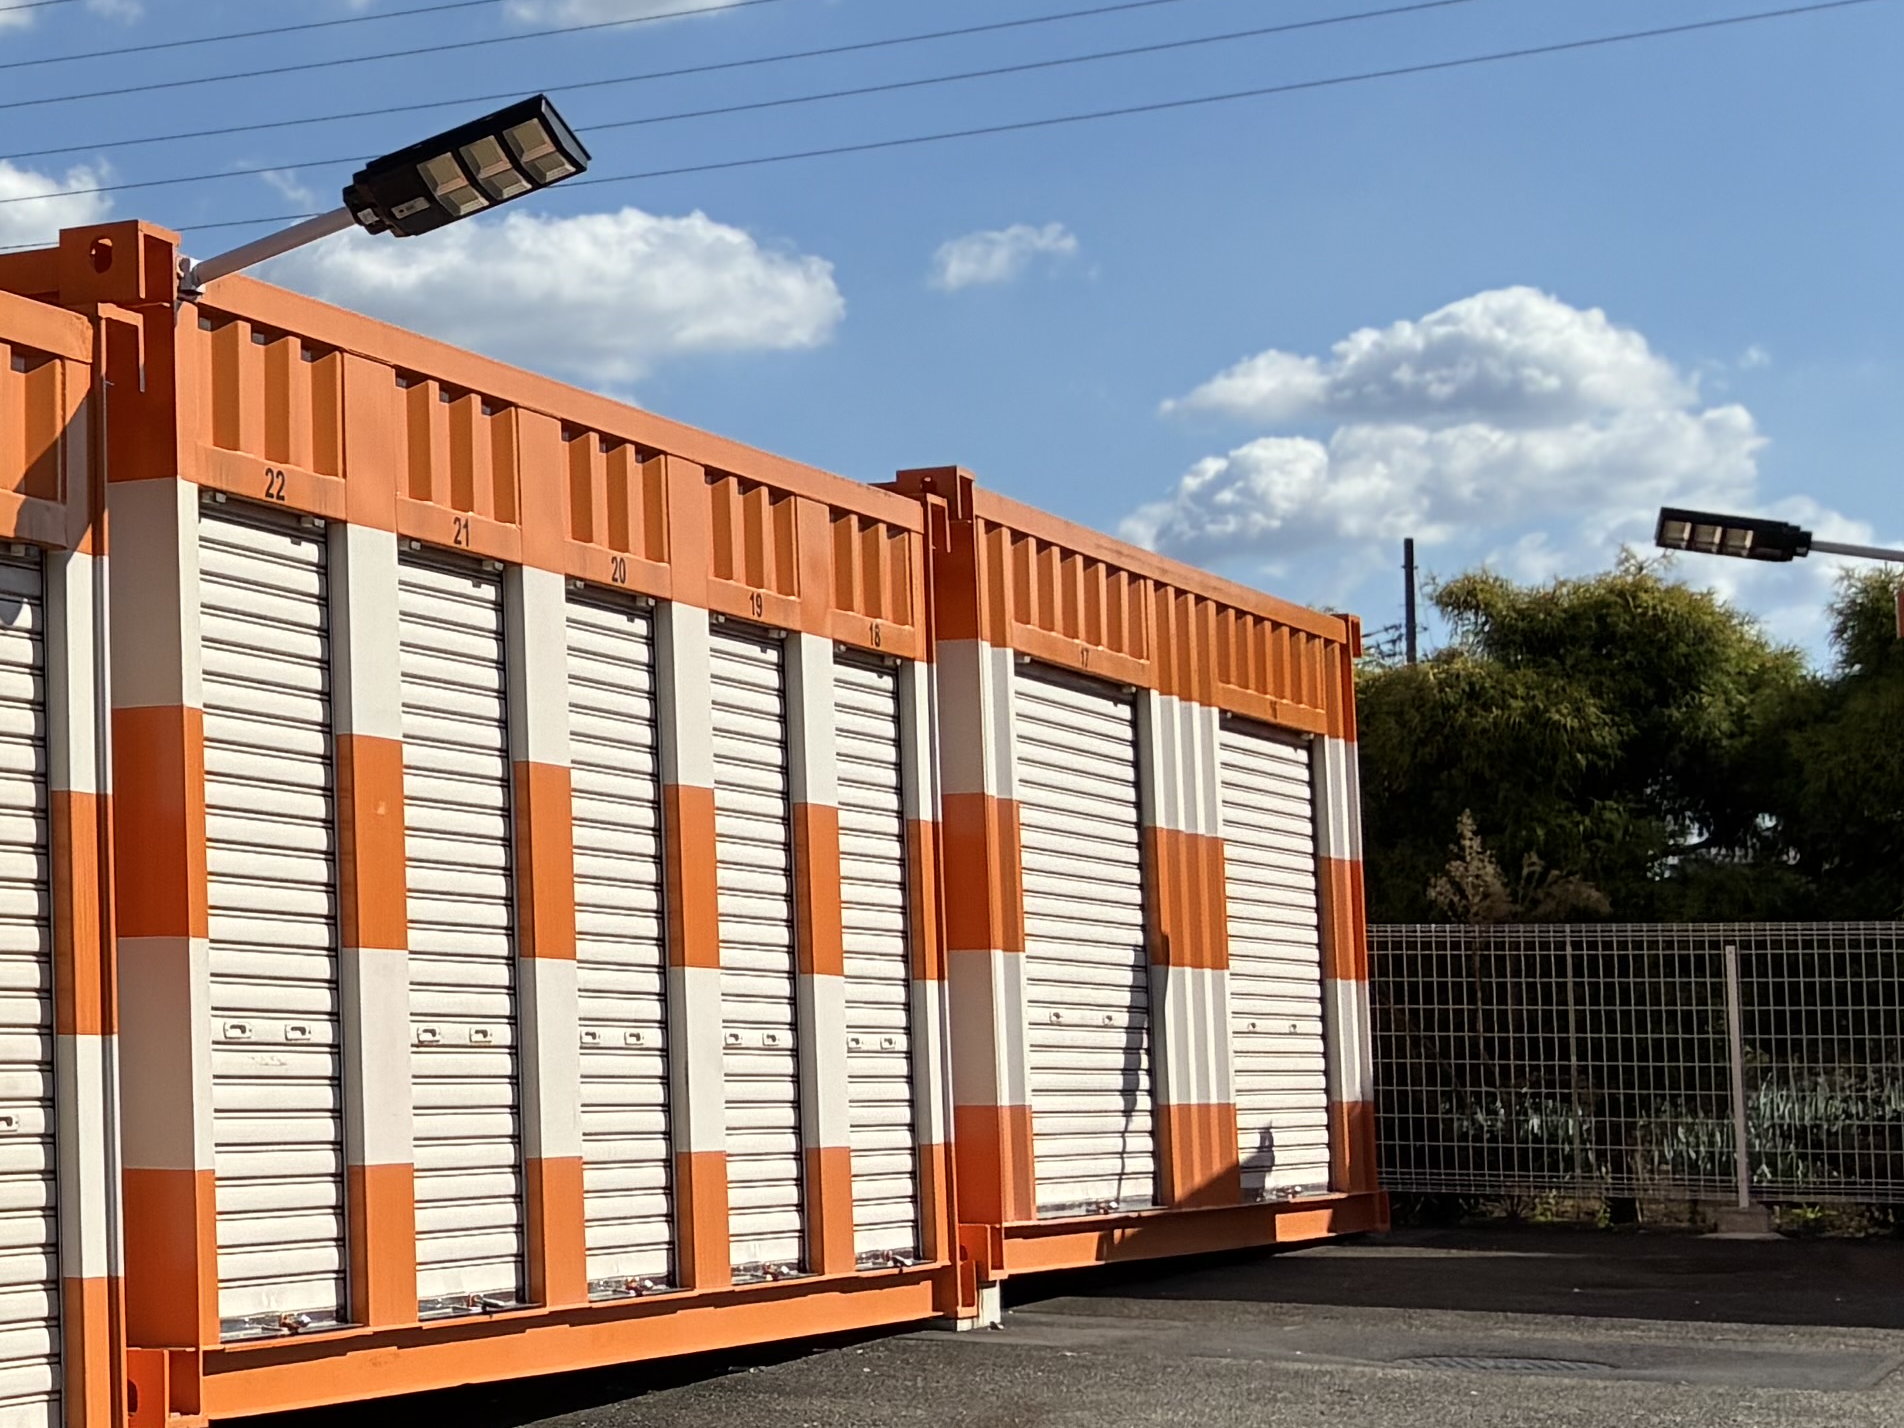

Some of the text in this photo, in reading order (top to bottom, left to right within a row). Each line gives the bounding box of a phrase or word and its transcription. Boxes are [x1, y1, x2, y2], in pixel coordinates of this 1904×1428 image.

[264, 468, 286, 502] 22
[452, 517, 470, 548] 21
[611, 556, 626, 585] 20
[749, 592, 763, 618] 19
[868, 622, 881, 648] 18
